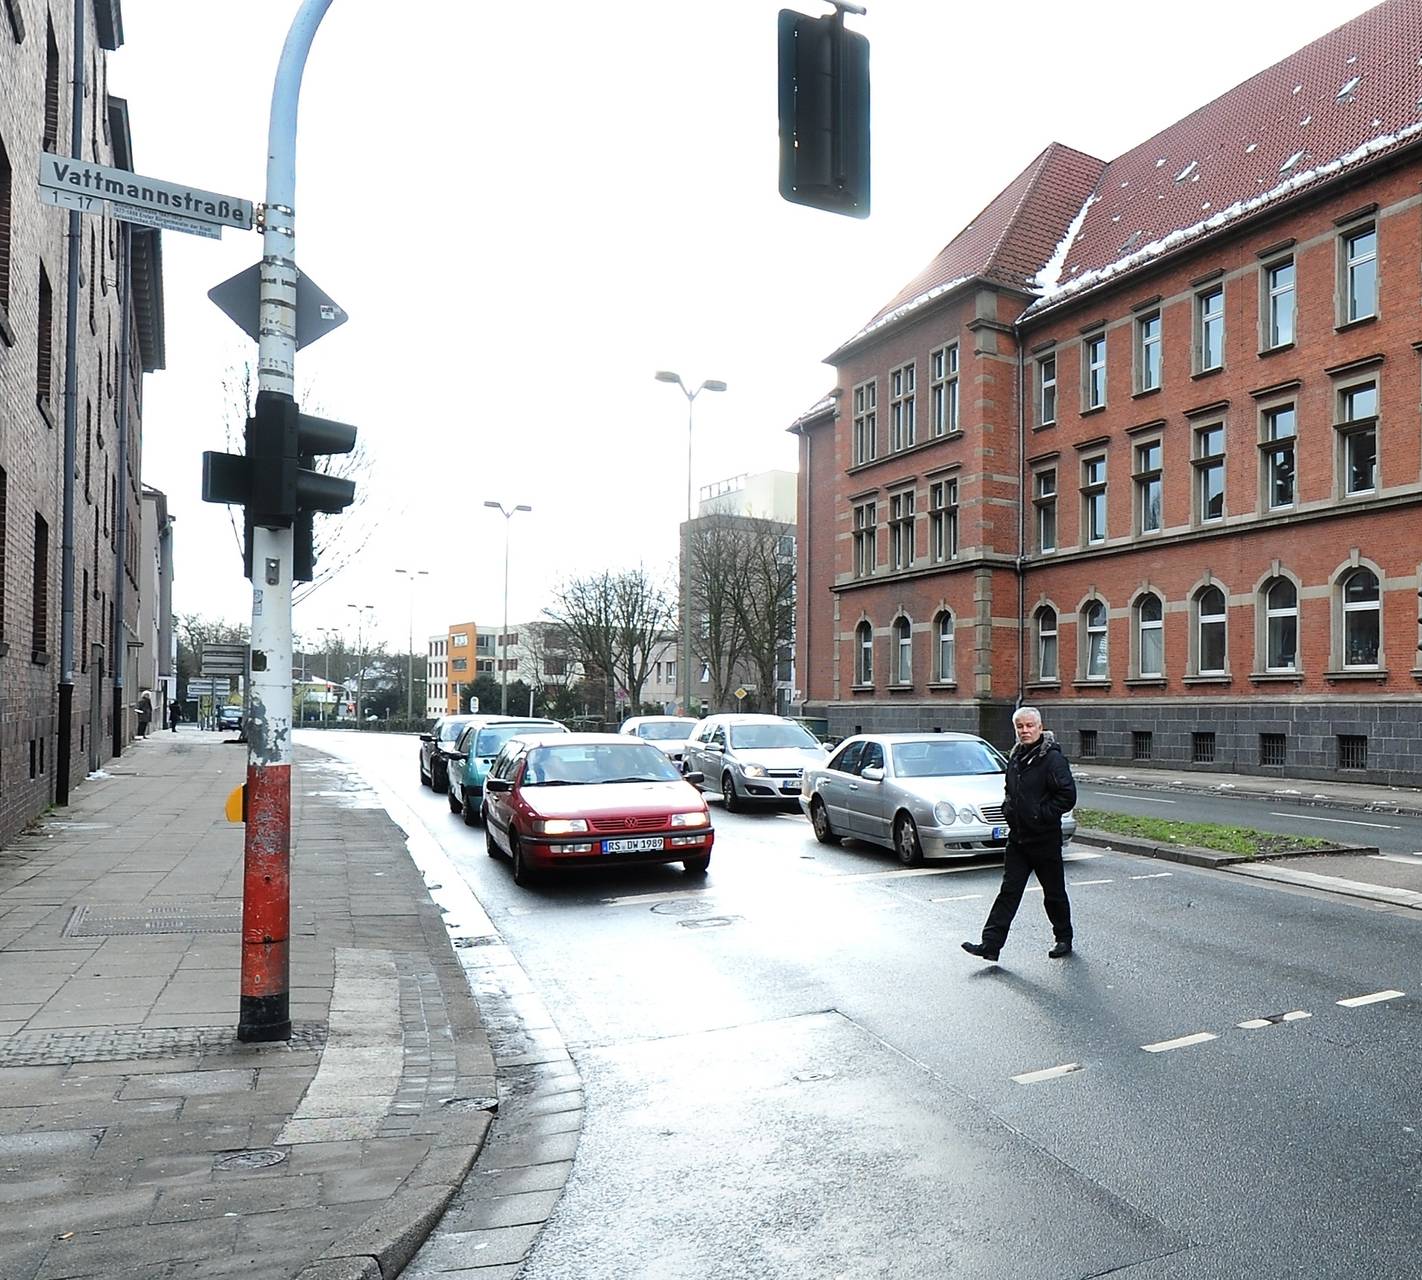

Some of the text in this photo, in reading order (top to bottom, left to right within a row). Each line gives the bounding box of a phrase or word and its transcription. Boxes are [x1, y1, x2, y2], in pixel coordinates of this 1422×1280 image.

[53, 161, 244, 221] Vattmannstraße
[53, 190, 58, 203] 1
[78, 196, 93, 210] 17
[608, 838, 663, 851] RS DW 1989
